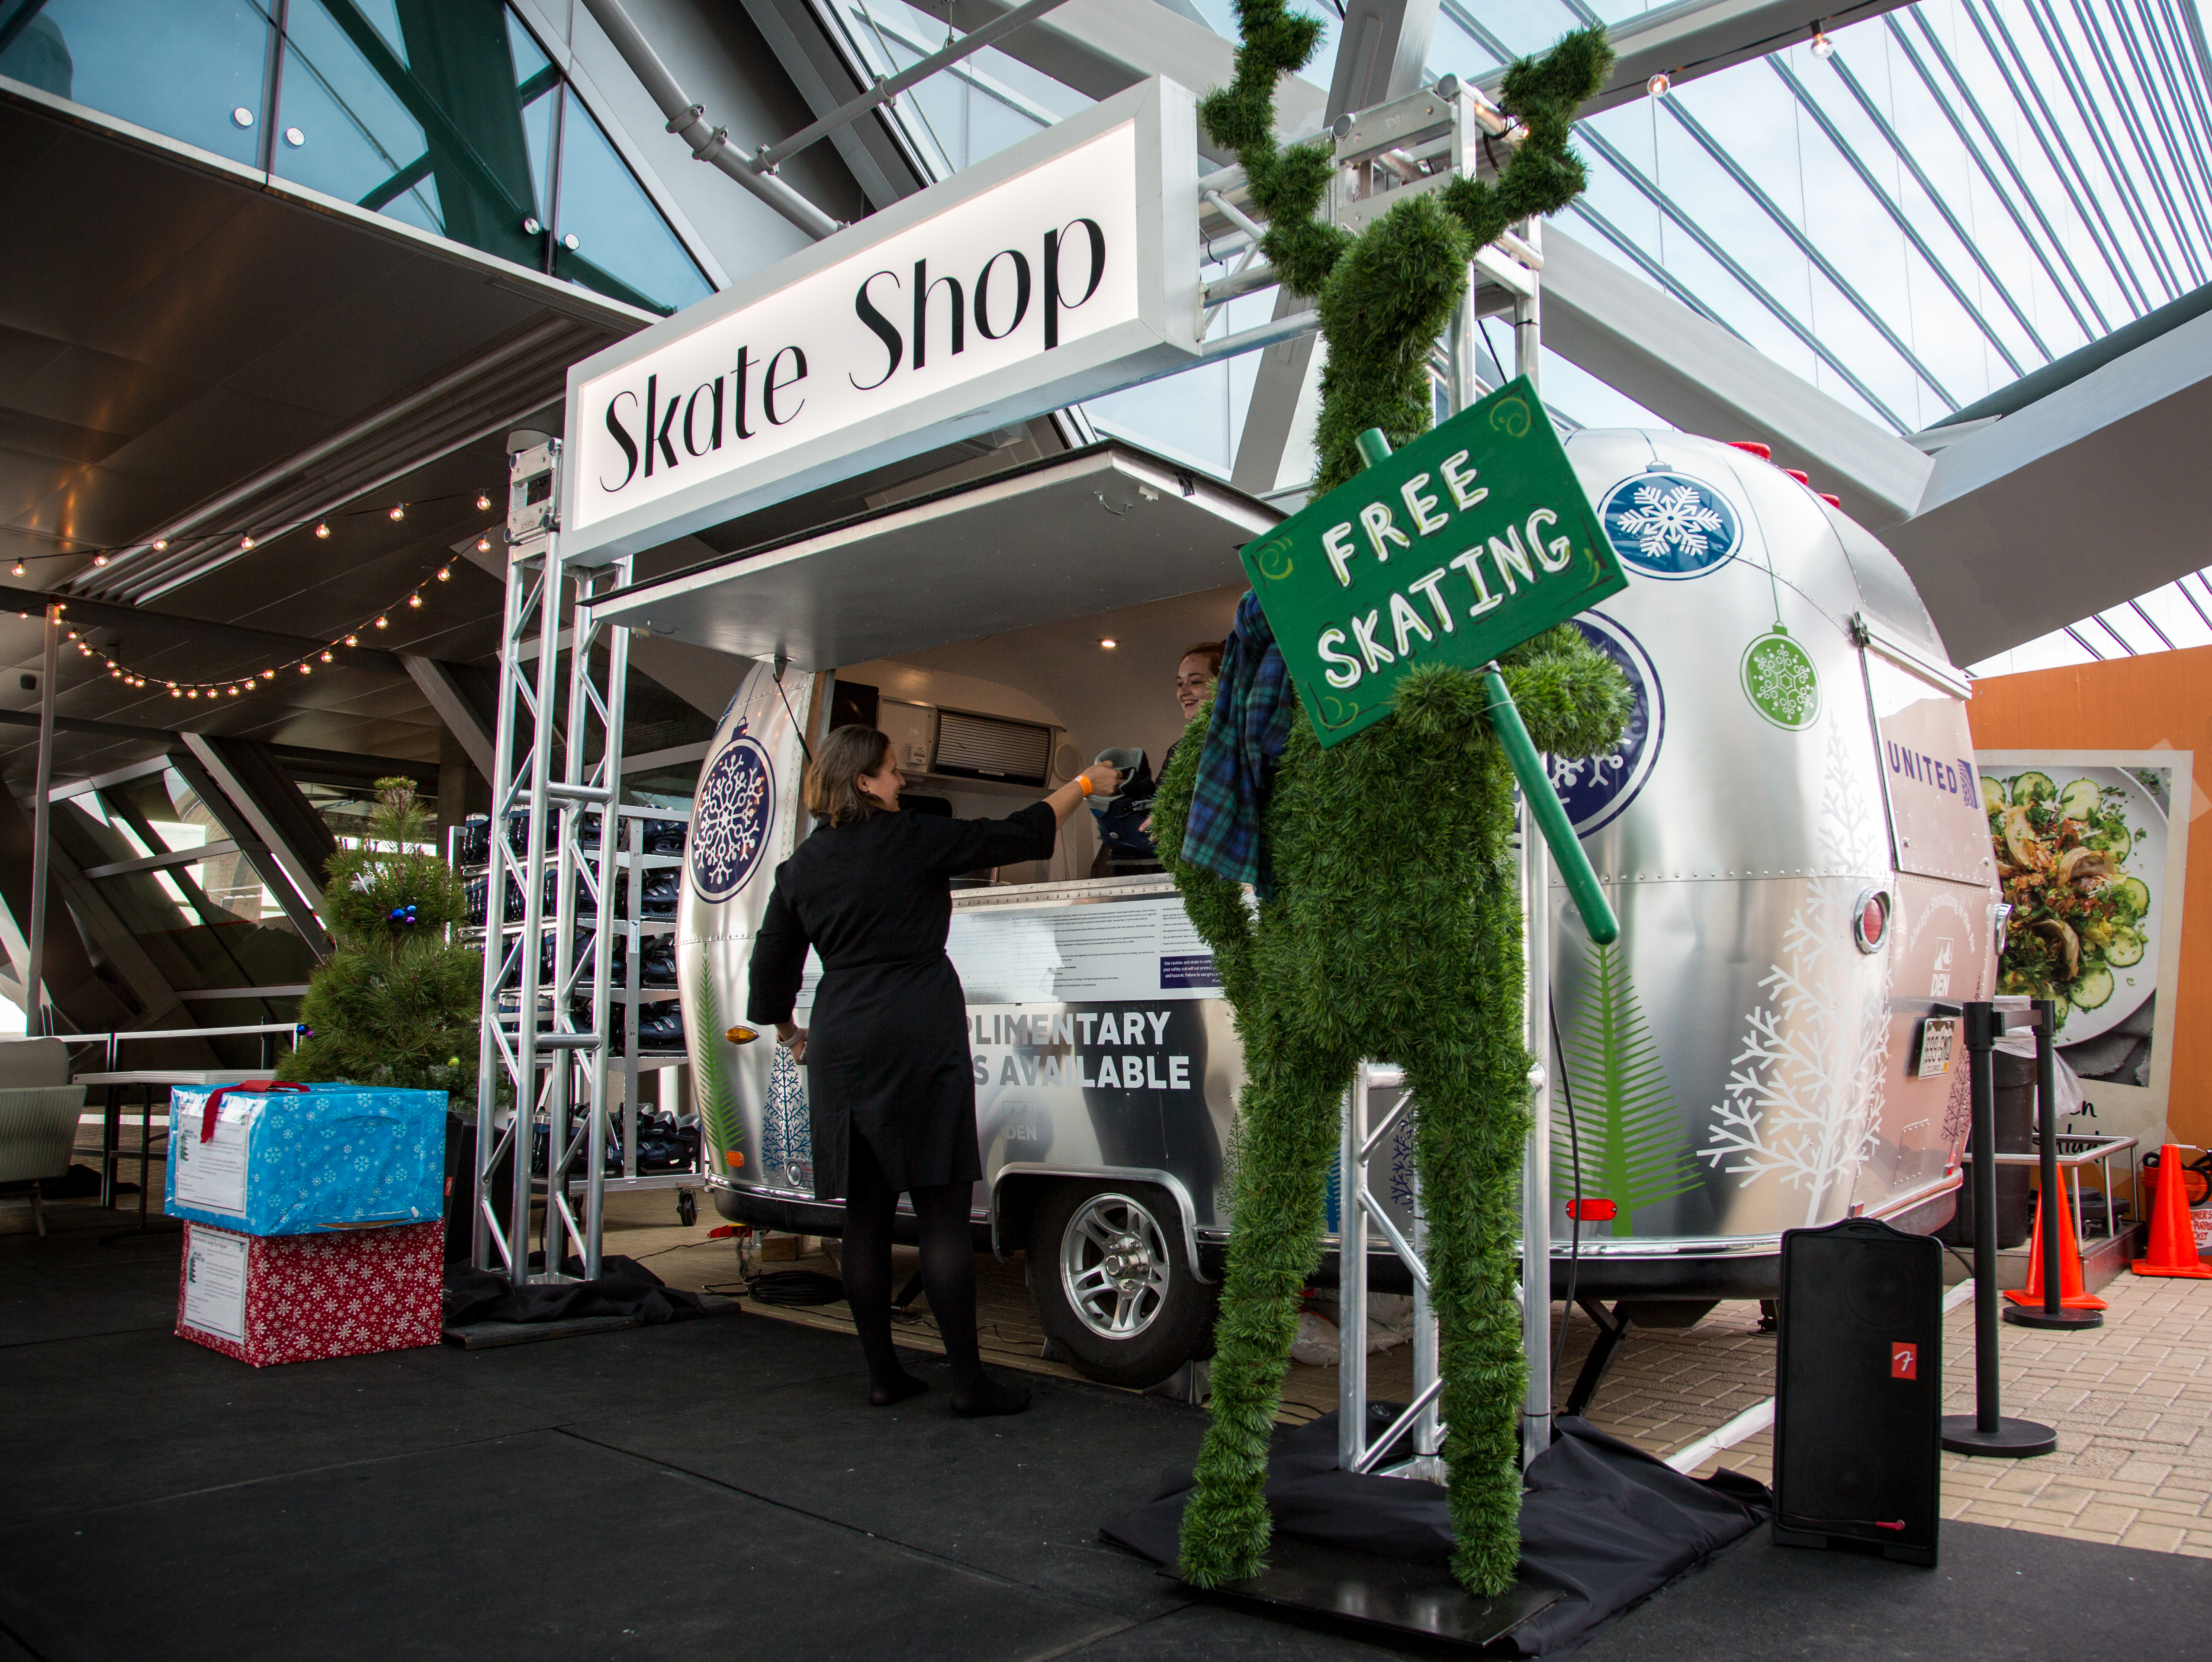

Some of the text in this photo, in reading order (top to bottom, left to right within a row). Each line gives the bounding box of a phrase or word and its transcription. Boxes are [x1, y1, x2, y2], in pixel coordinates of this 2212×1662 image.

[599, 218, 1106, 493] Skate Shop
[1322, 450, 1489, 588] FREE
[1318, 508, 1572, 689] SKATING
[1888, 740, 1958, 794] UNITED
[1910, 905, 1930, 952] Always
[1930, 893, 1959, 915] Something
[1958, 899, 1964, 918] in
[1963, 910, 1971, 935] the
[1930, 973, 1951, 997] DEN
[1000, 1055, 1190, 1089] AVAILABLE
[1006, 1125, 1037, 1140] DEN
